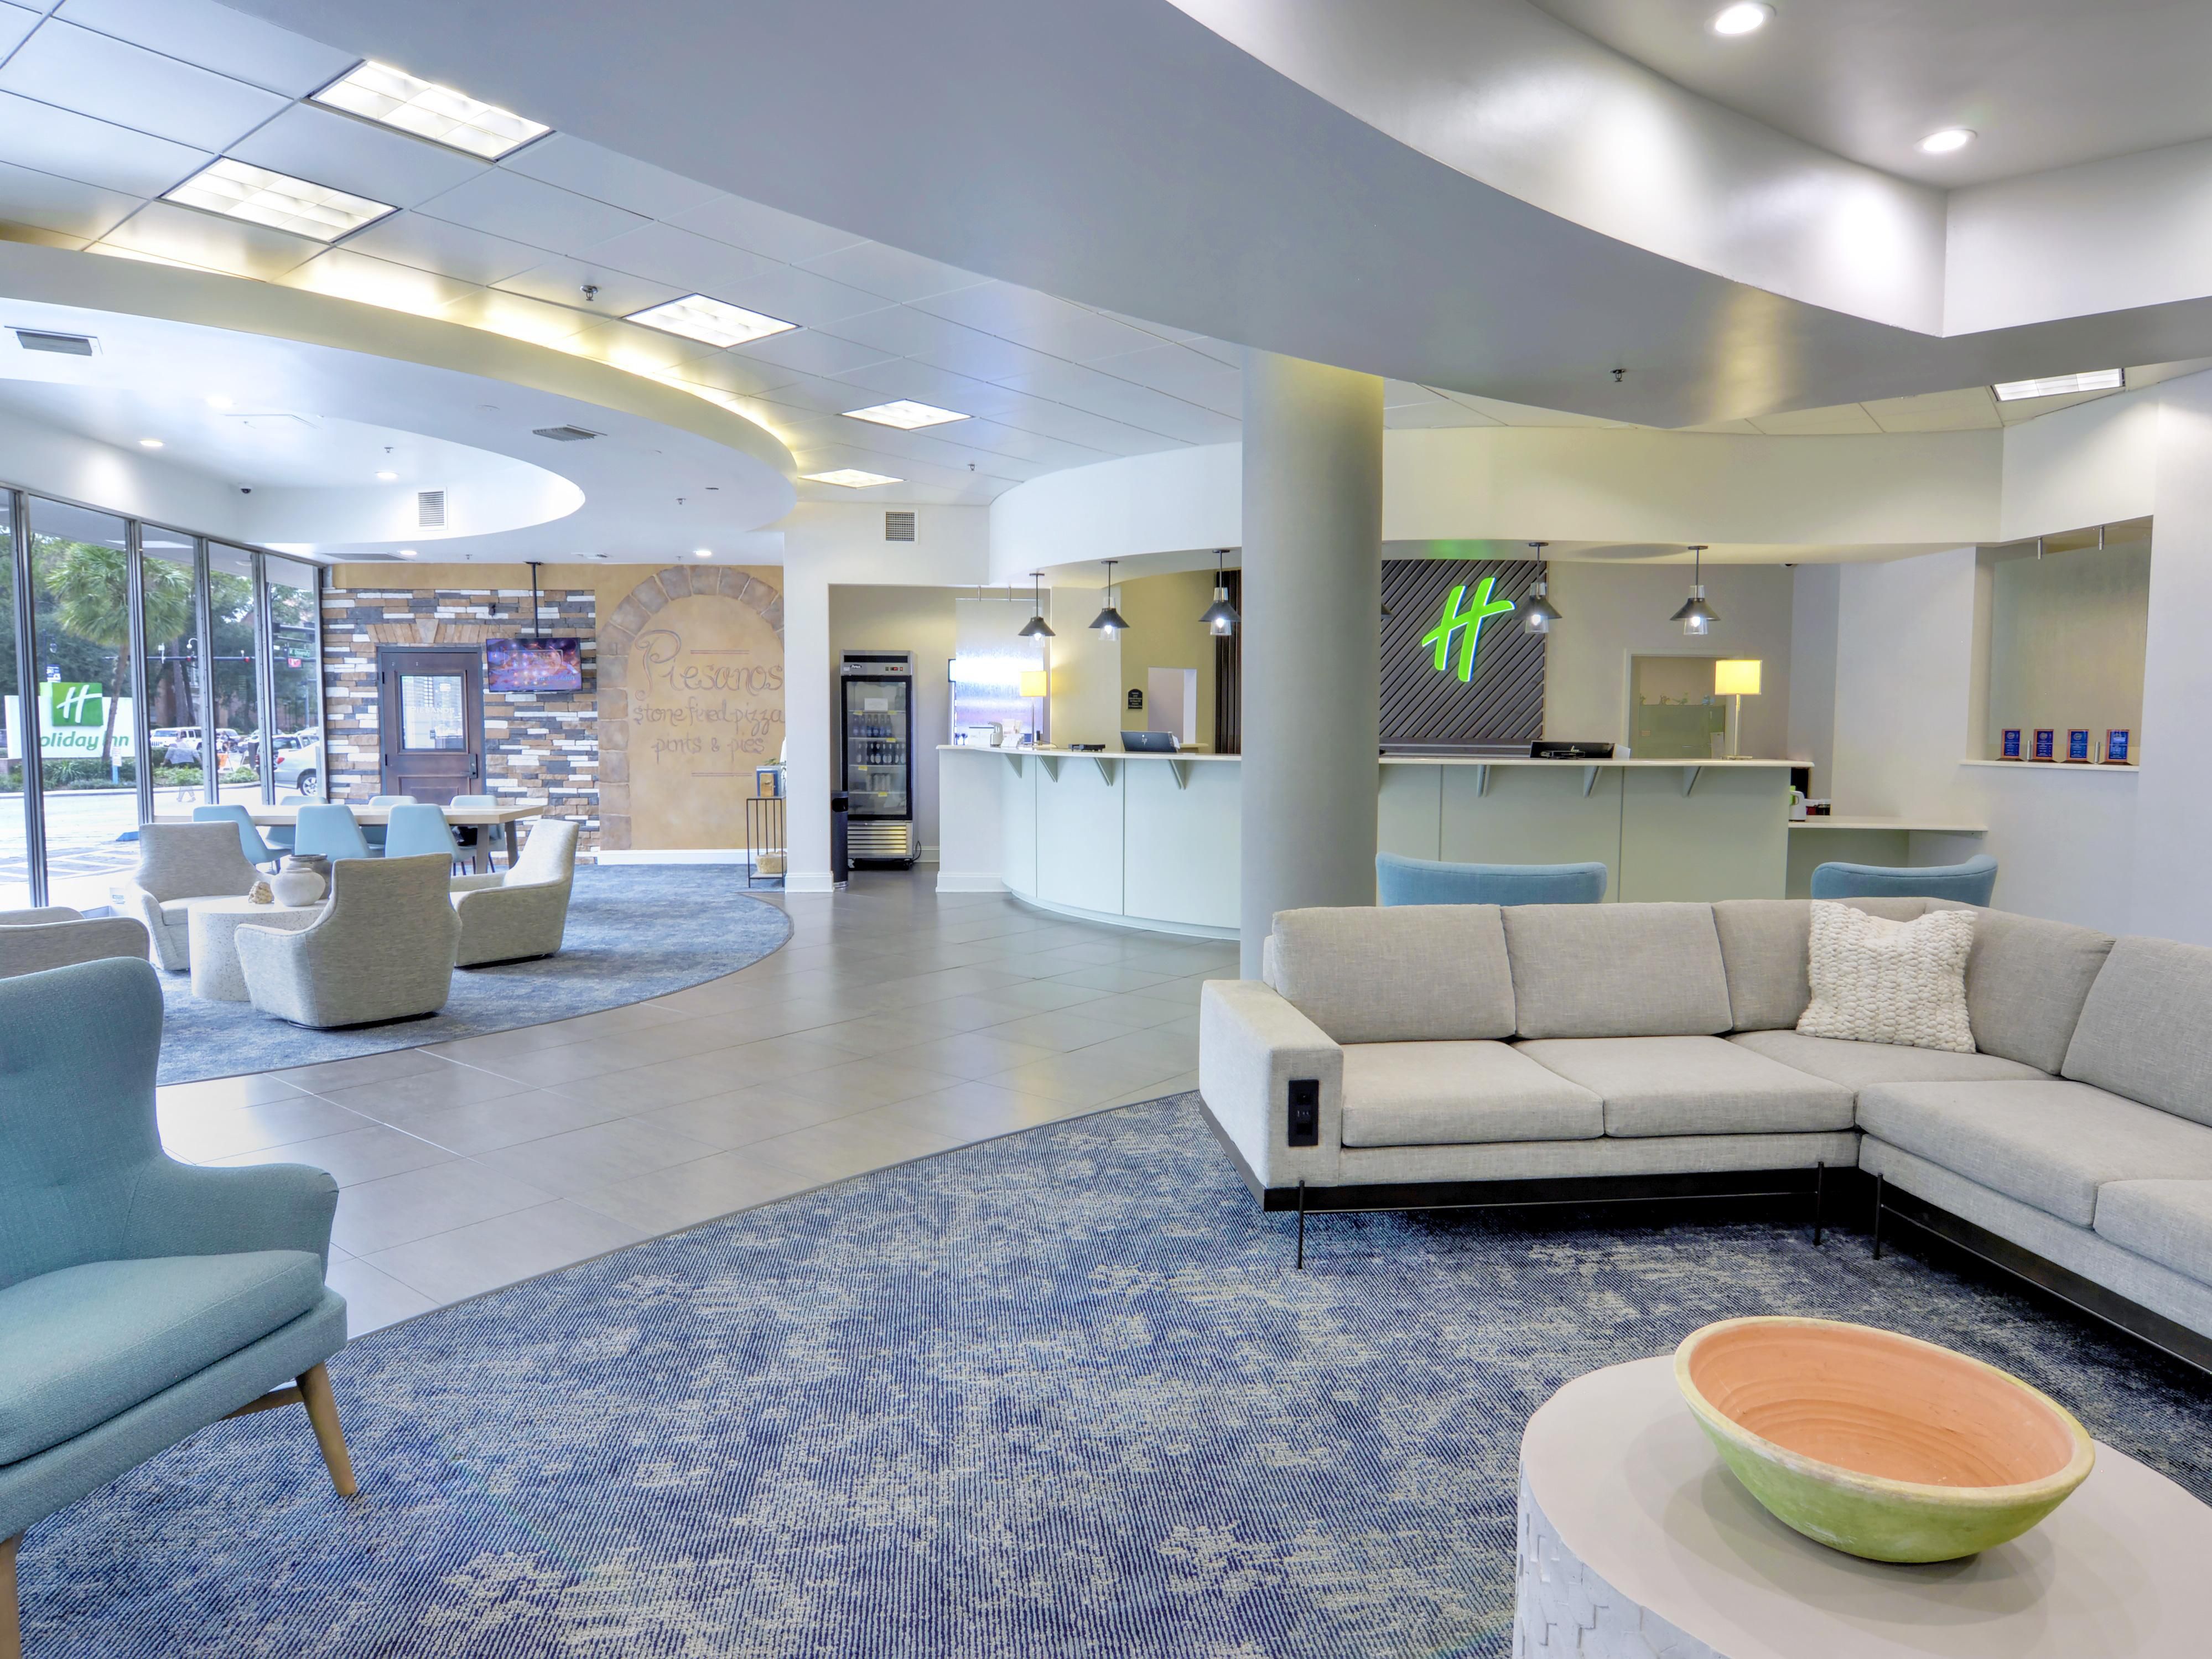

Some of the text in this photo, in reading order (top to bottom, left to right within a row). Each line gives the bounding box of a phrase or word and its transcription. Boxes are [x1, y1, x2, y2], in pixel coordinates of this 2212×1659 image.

[1421, 577, 1516, 682] H
[635, 629, 783, 701] Piesanos
[56, 685, 102, 723] H
[634, 697, 785, 736] stone fired pizza
[40, 731, 99, 750] oliday
[651, 732, 765, 764] pints & pies
